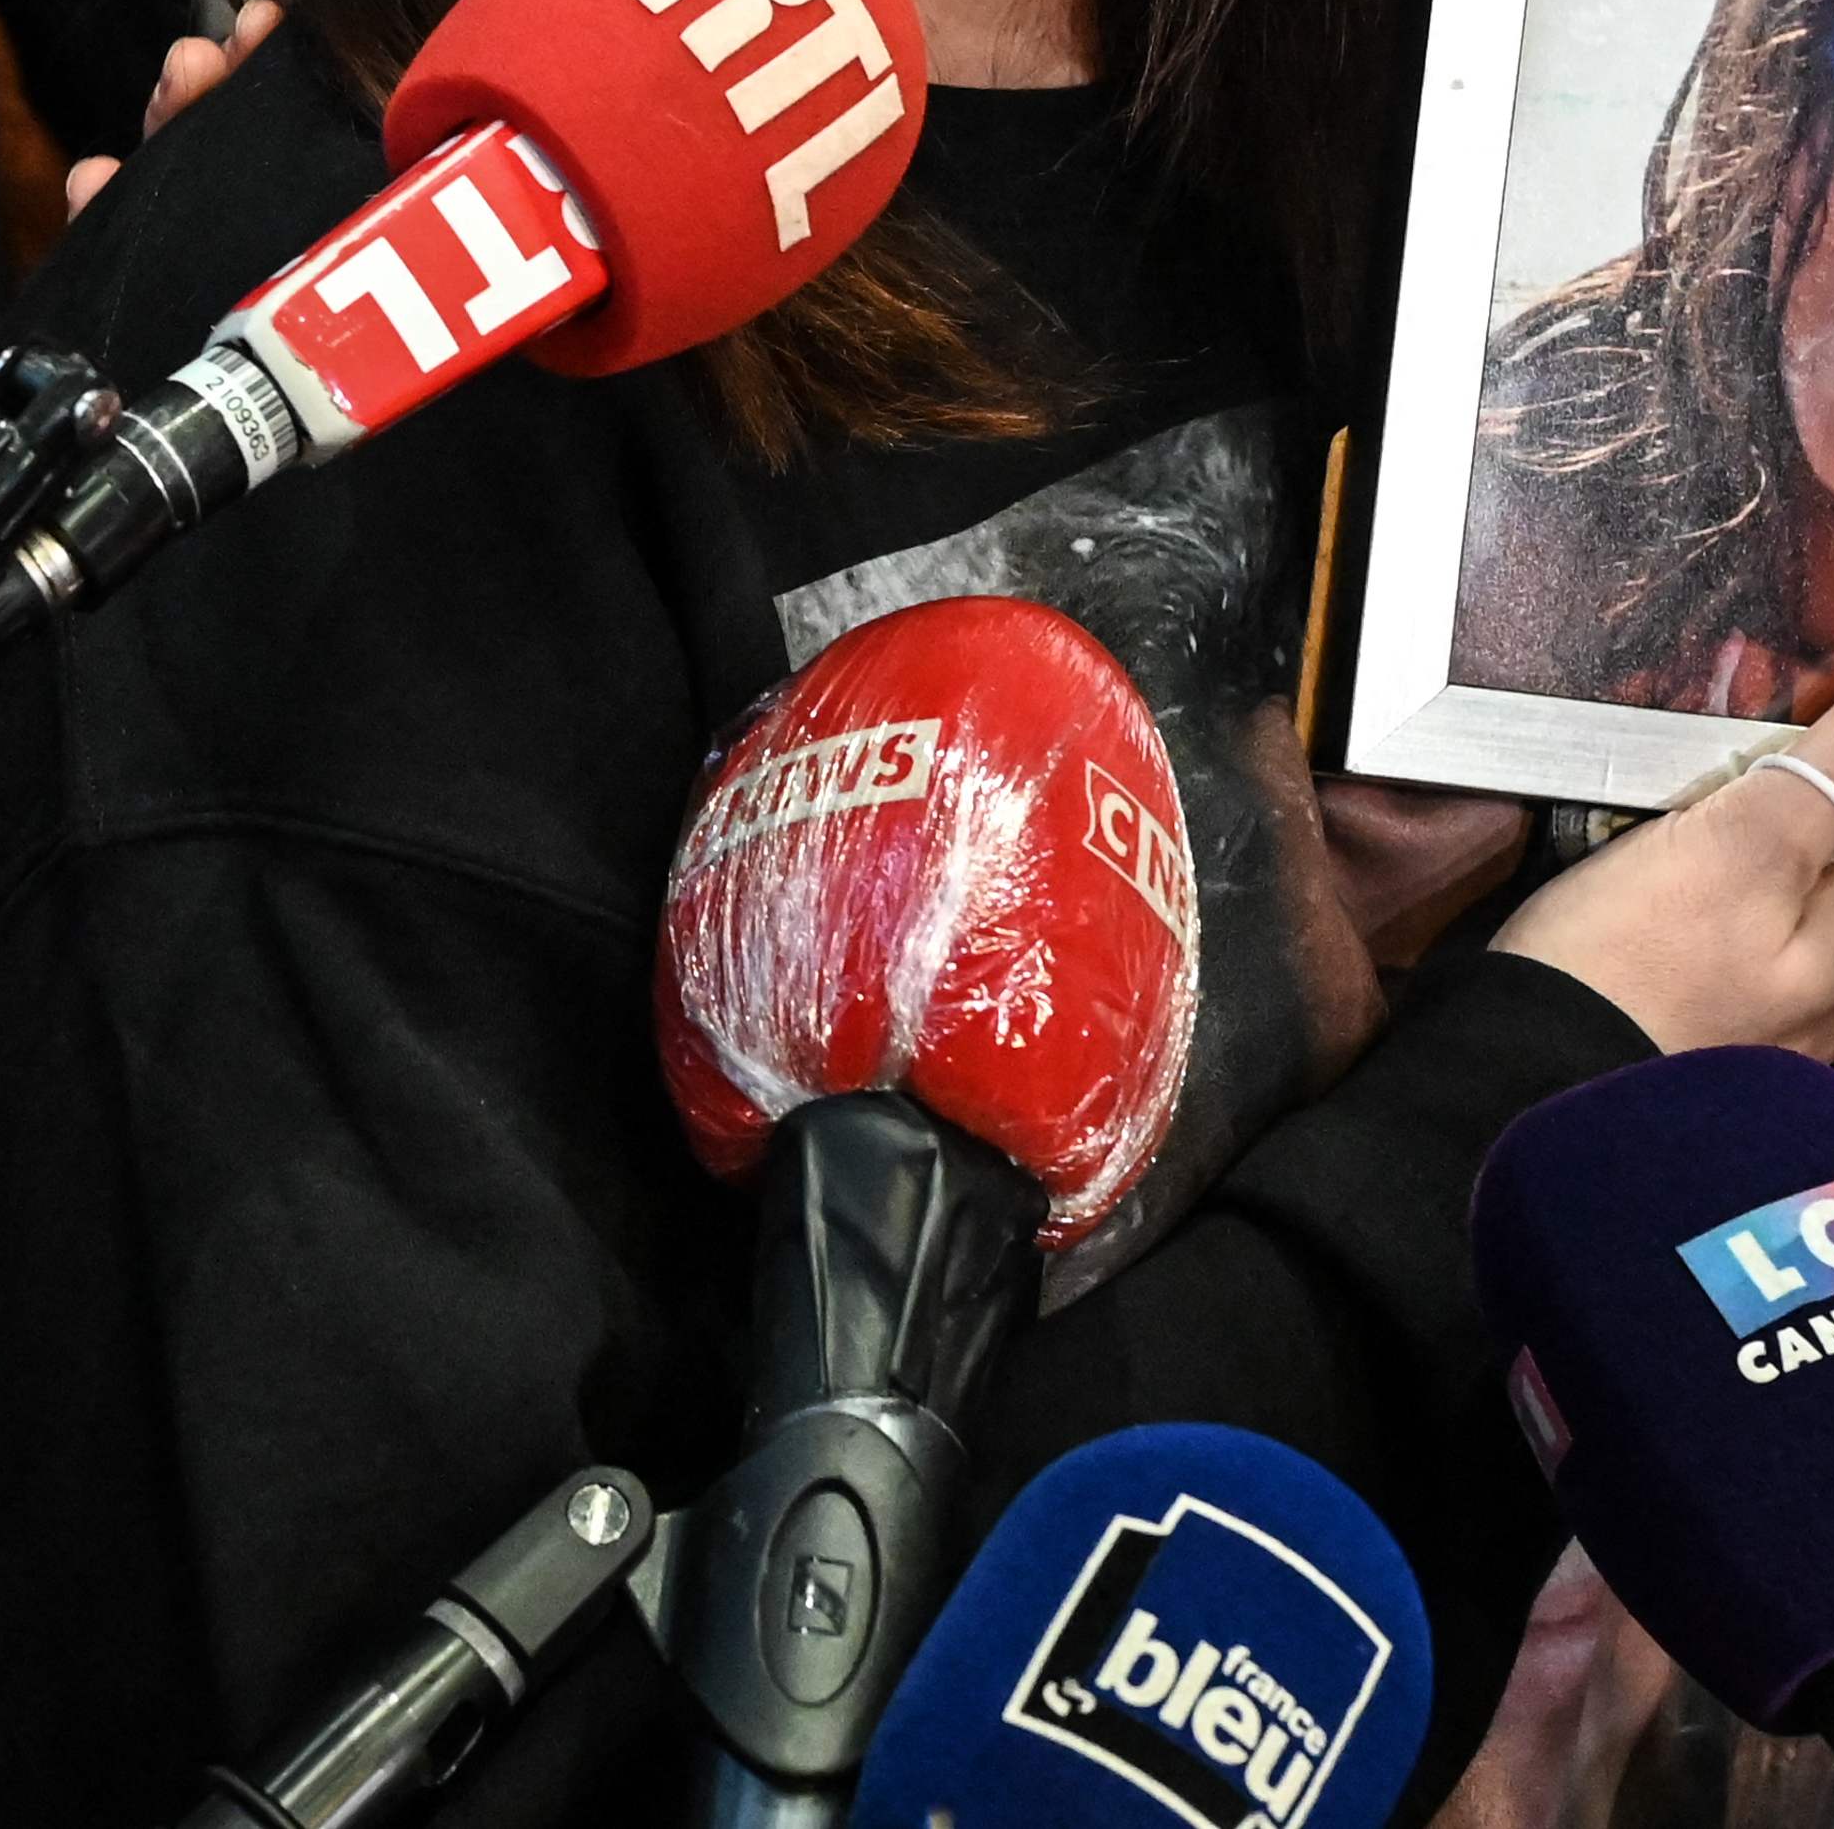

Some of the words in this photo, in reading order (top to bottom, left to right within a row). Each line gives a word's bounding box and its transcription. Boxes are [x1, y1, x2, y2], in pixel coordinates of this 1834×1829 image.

[204, 376, 270, 462] 2109363
[1094, 1607, 1314, 1822] bleu
[1221, 1643, 1328, 1757] france
